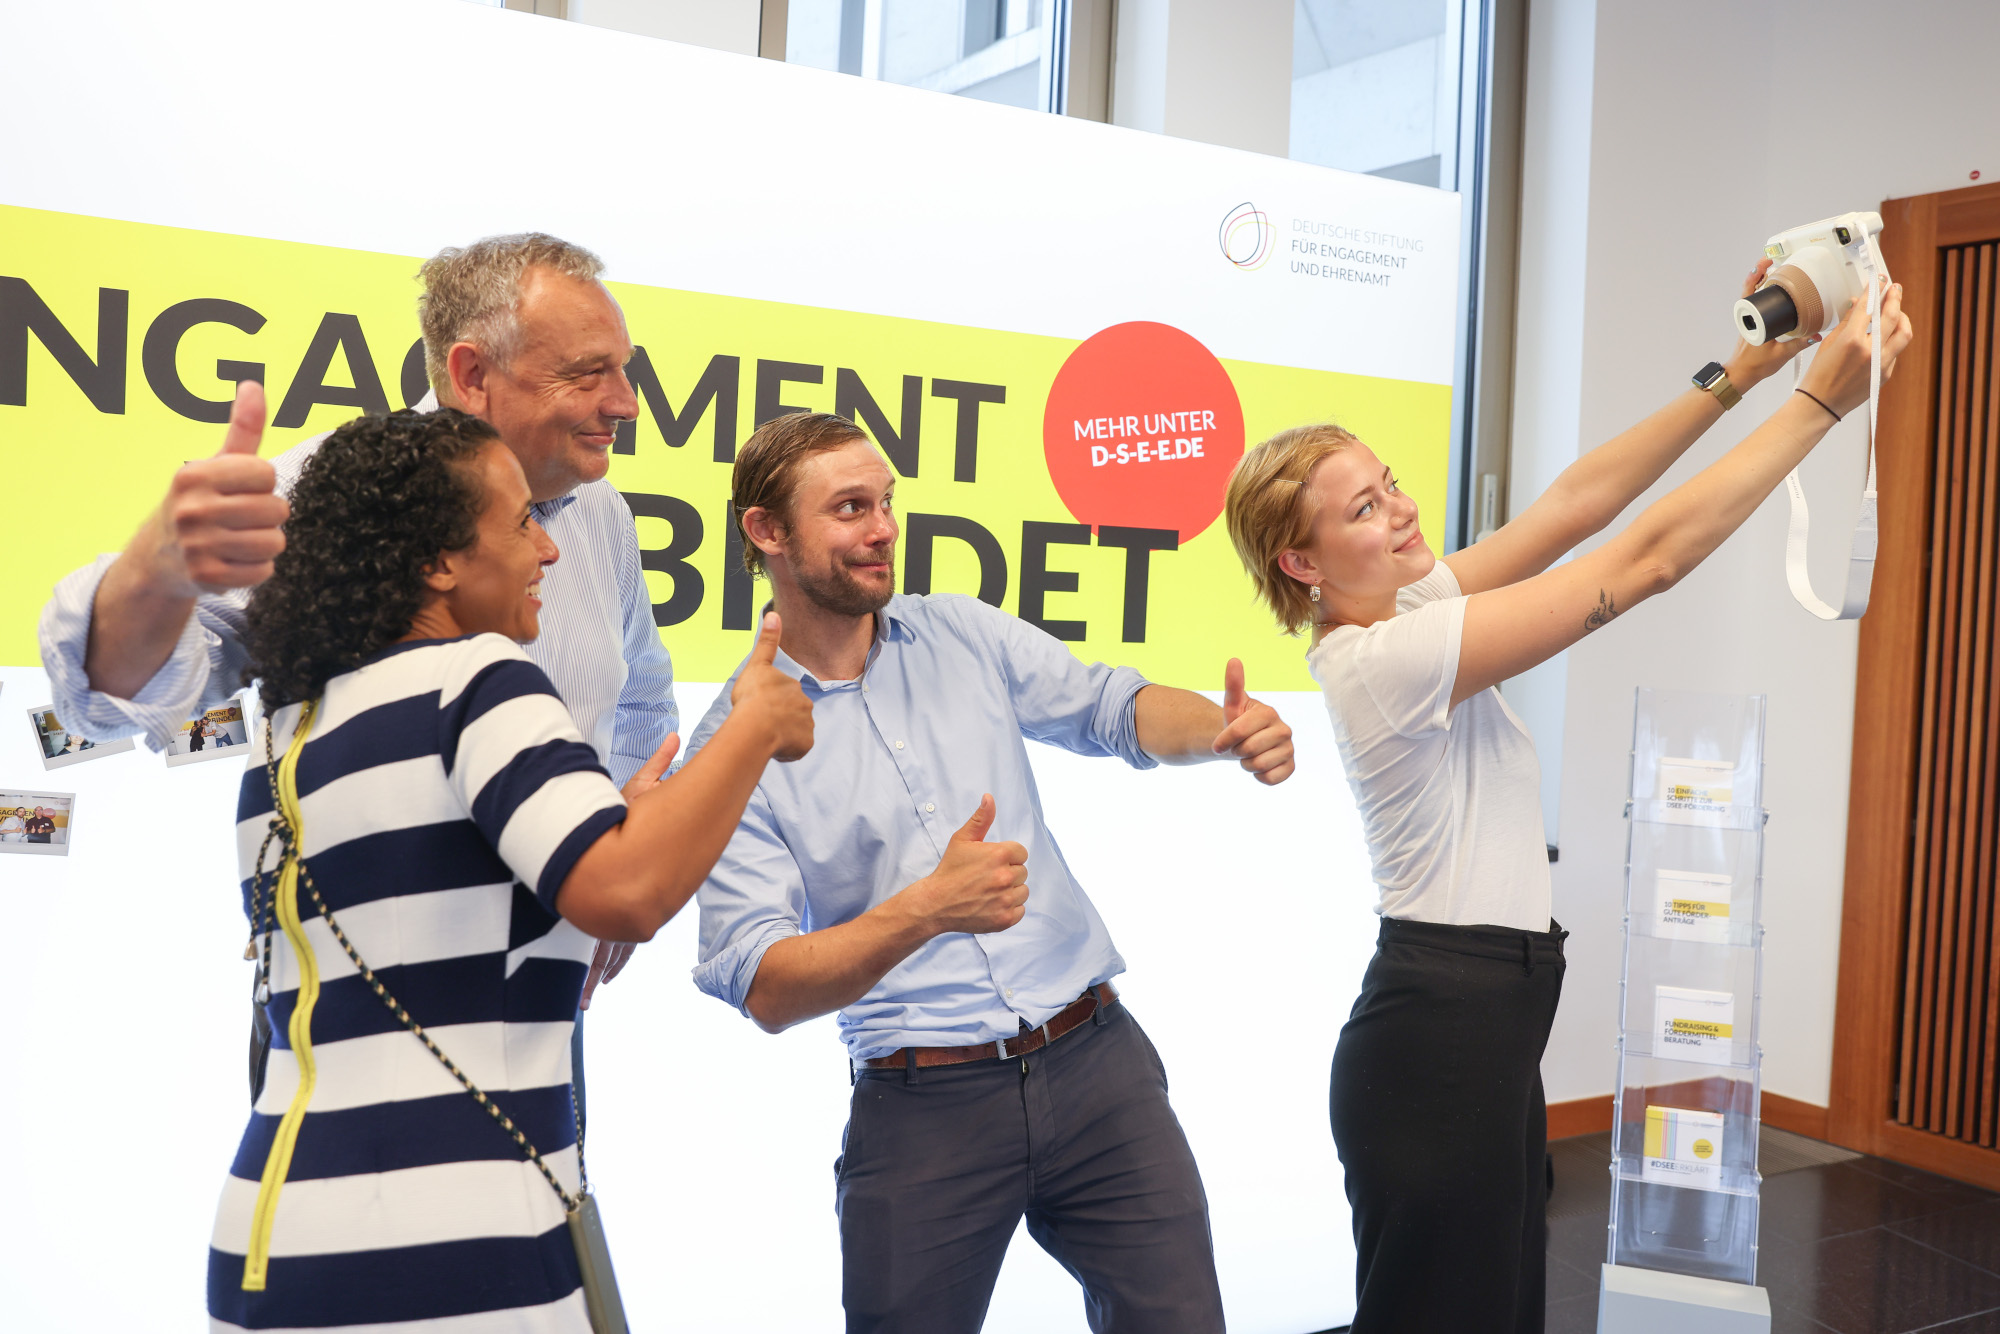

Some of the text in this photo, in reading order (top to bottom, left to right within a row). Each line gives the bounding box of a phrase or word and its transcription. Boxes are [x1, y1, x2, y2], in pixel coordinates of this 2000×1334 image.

[1292, 218, 1424, 252] DEUTSCHE STIFTUNG
[1291, 238, 1408, 270] FÜR ENGAGEMENT
[1290, 260, 1391, 287] UND EHRENAMT
[1074, 409, 1217, 441] MEHR UNTER
[1091, 436, 1205, 467] D-S-E-E.DE
[1676, 787, 1708, 796] EINFACHE
[1666, 795, 1698, 803] SCHRITTE
[1673, 902, 1692, 910] TIPPS
[1692, 902, 1706, 910] FÜR
[1663, 909, 1682, 917] GUTE
[1663, 917, 1695, 925] ANTRÄGE
[1665, 1020, 1713, 1032] FUNDRAISING
[1664, 1028, 1719, 1041] FÖRDERMITTEL-
[1664, 1037, 1701, 1046] BERATUNG
